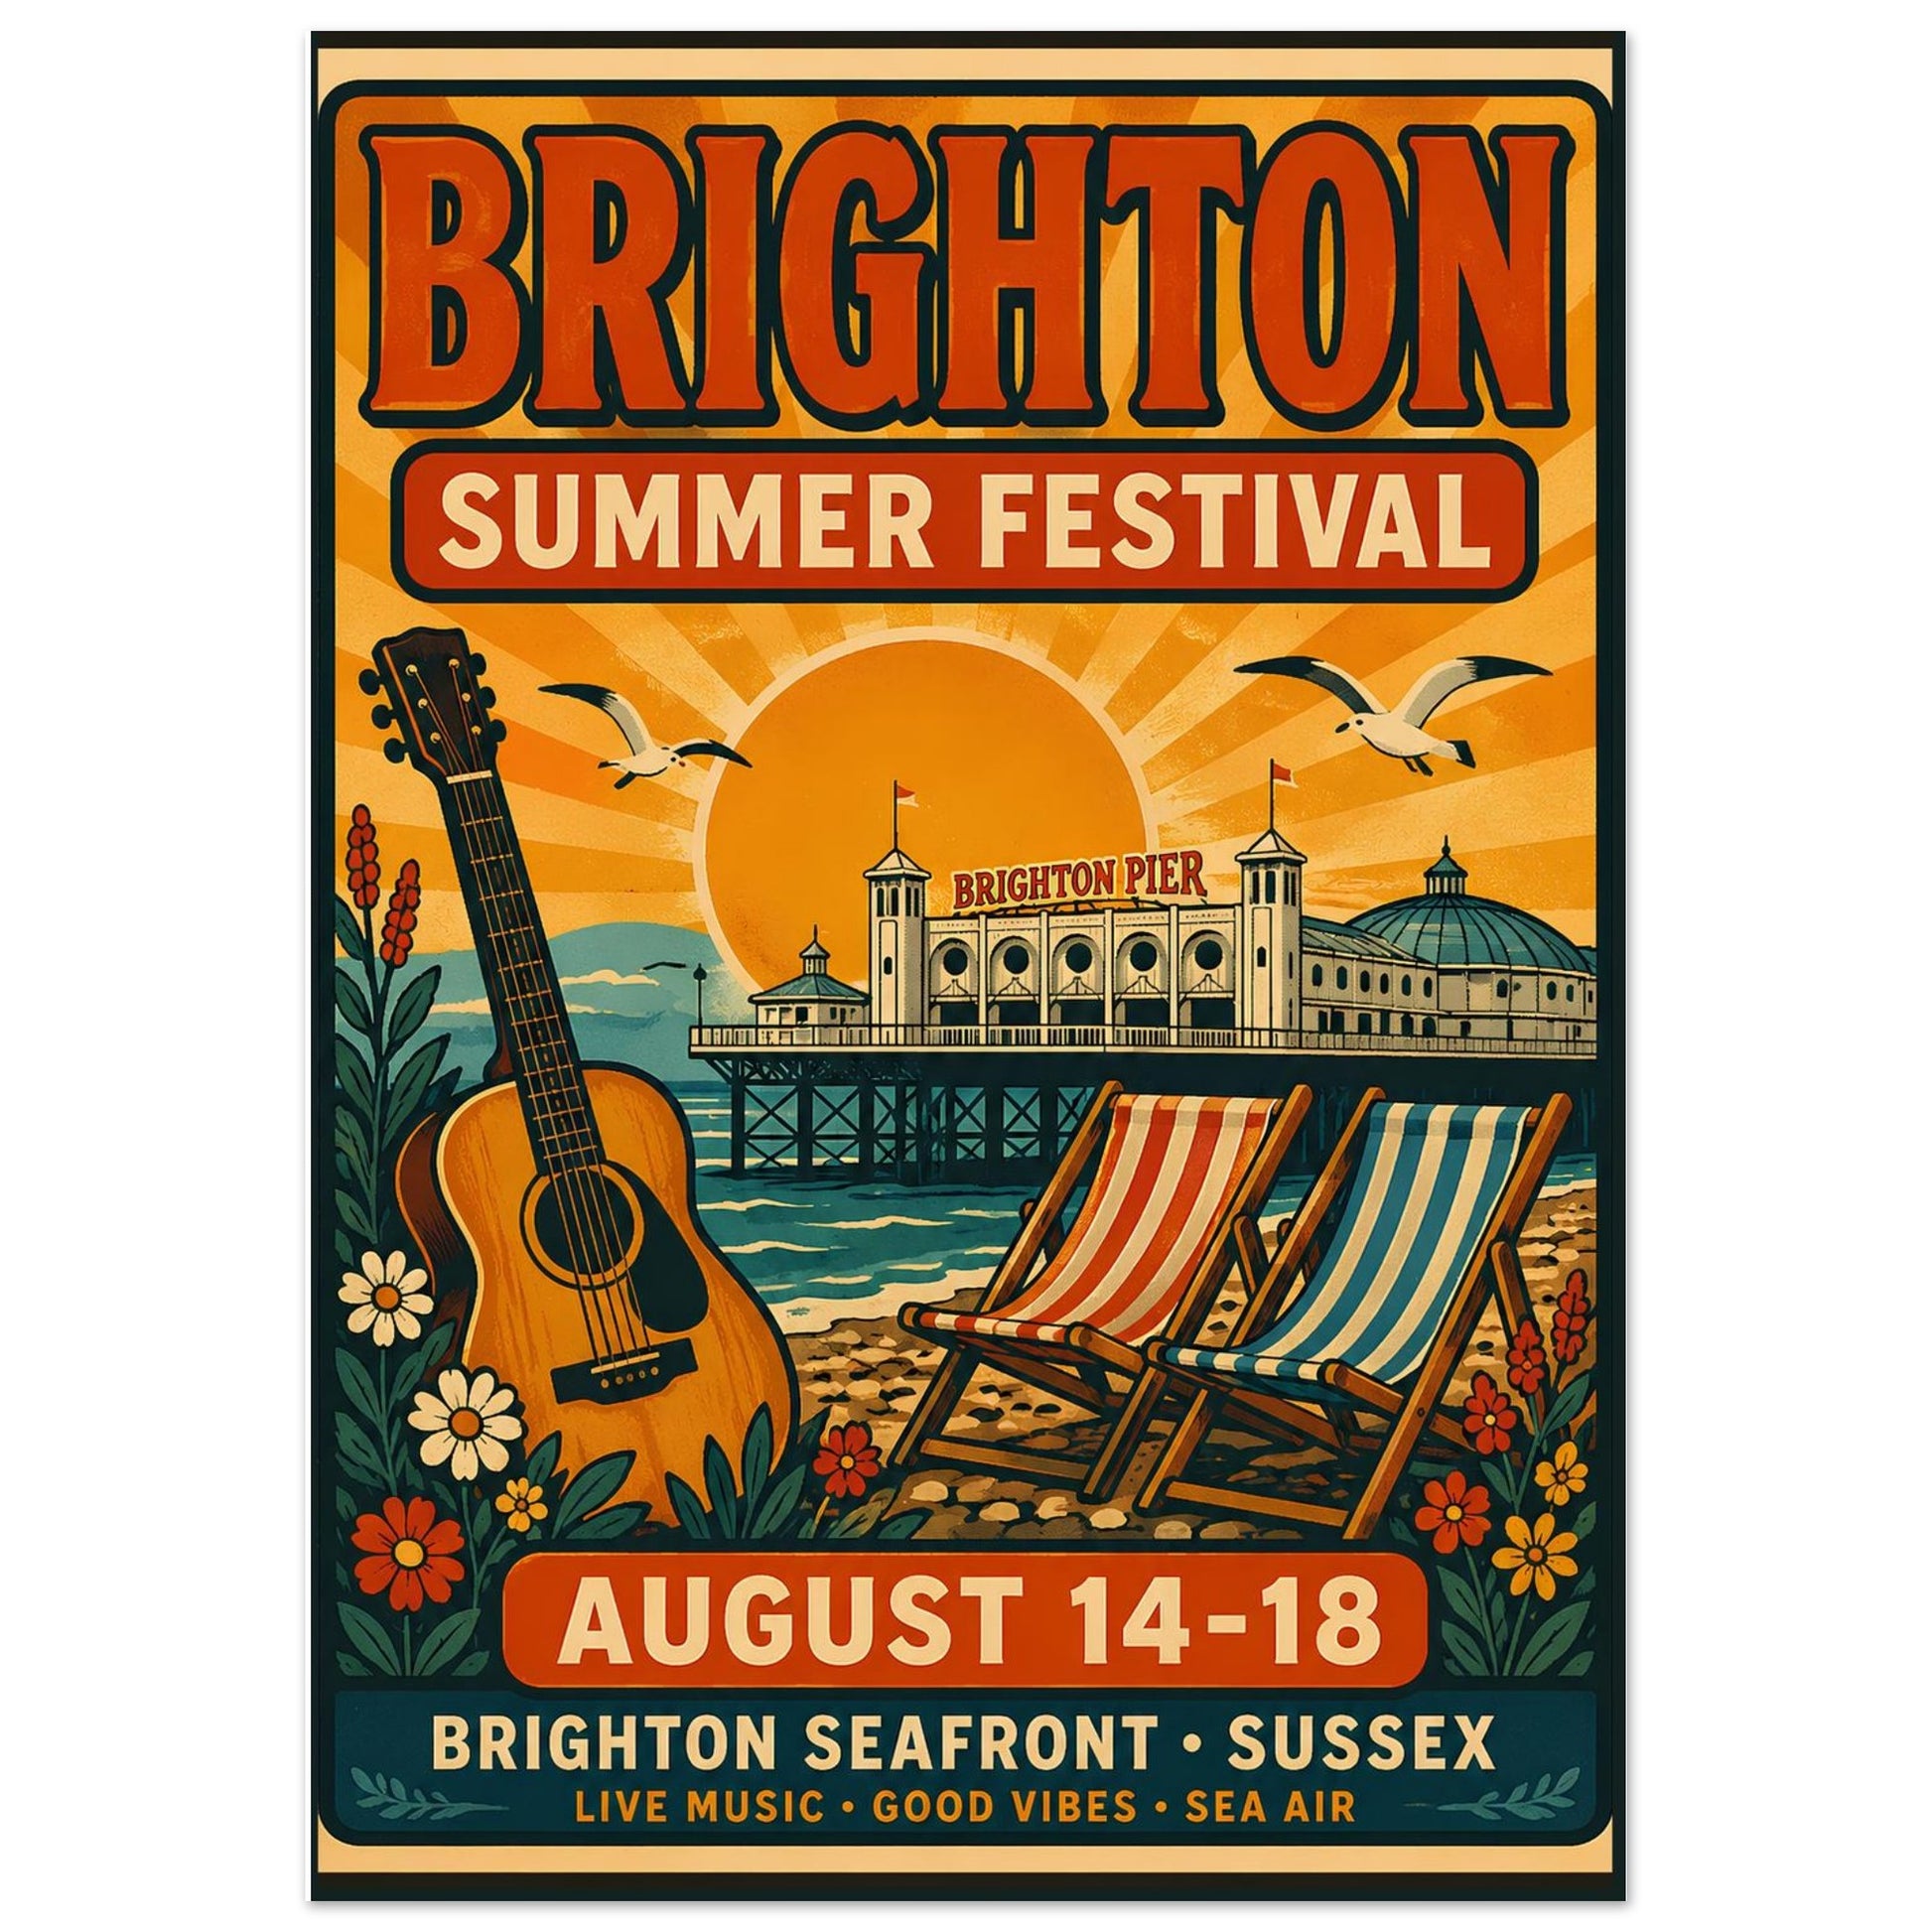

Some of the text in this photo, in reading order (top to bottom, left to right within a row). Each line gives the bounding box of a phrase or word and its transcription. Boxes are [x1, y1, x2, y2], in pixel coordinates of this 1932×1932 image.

[360, 121, 1572, 430] BRIGHTON
[439, 472, 1491, 570] SUMMER FESTIVAL
[952, 850, 1208, 910] BRIGHTON PIER
[557, 1575, 1381, 1666] AUGUST 14-18
[433, 1714, 1495, 1771] BRIGHTON SEAFRONT SUSSEX
[576, 1790, 1355, 1823] LIVE MUSIC GOOD VIBES SEA AIR
